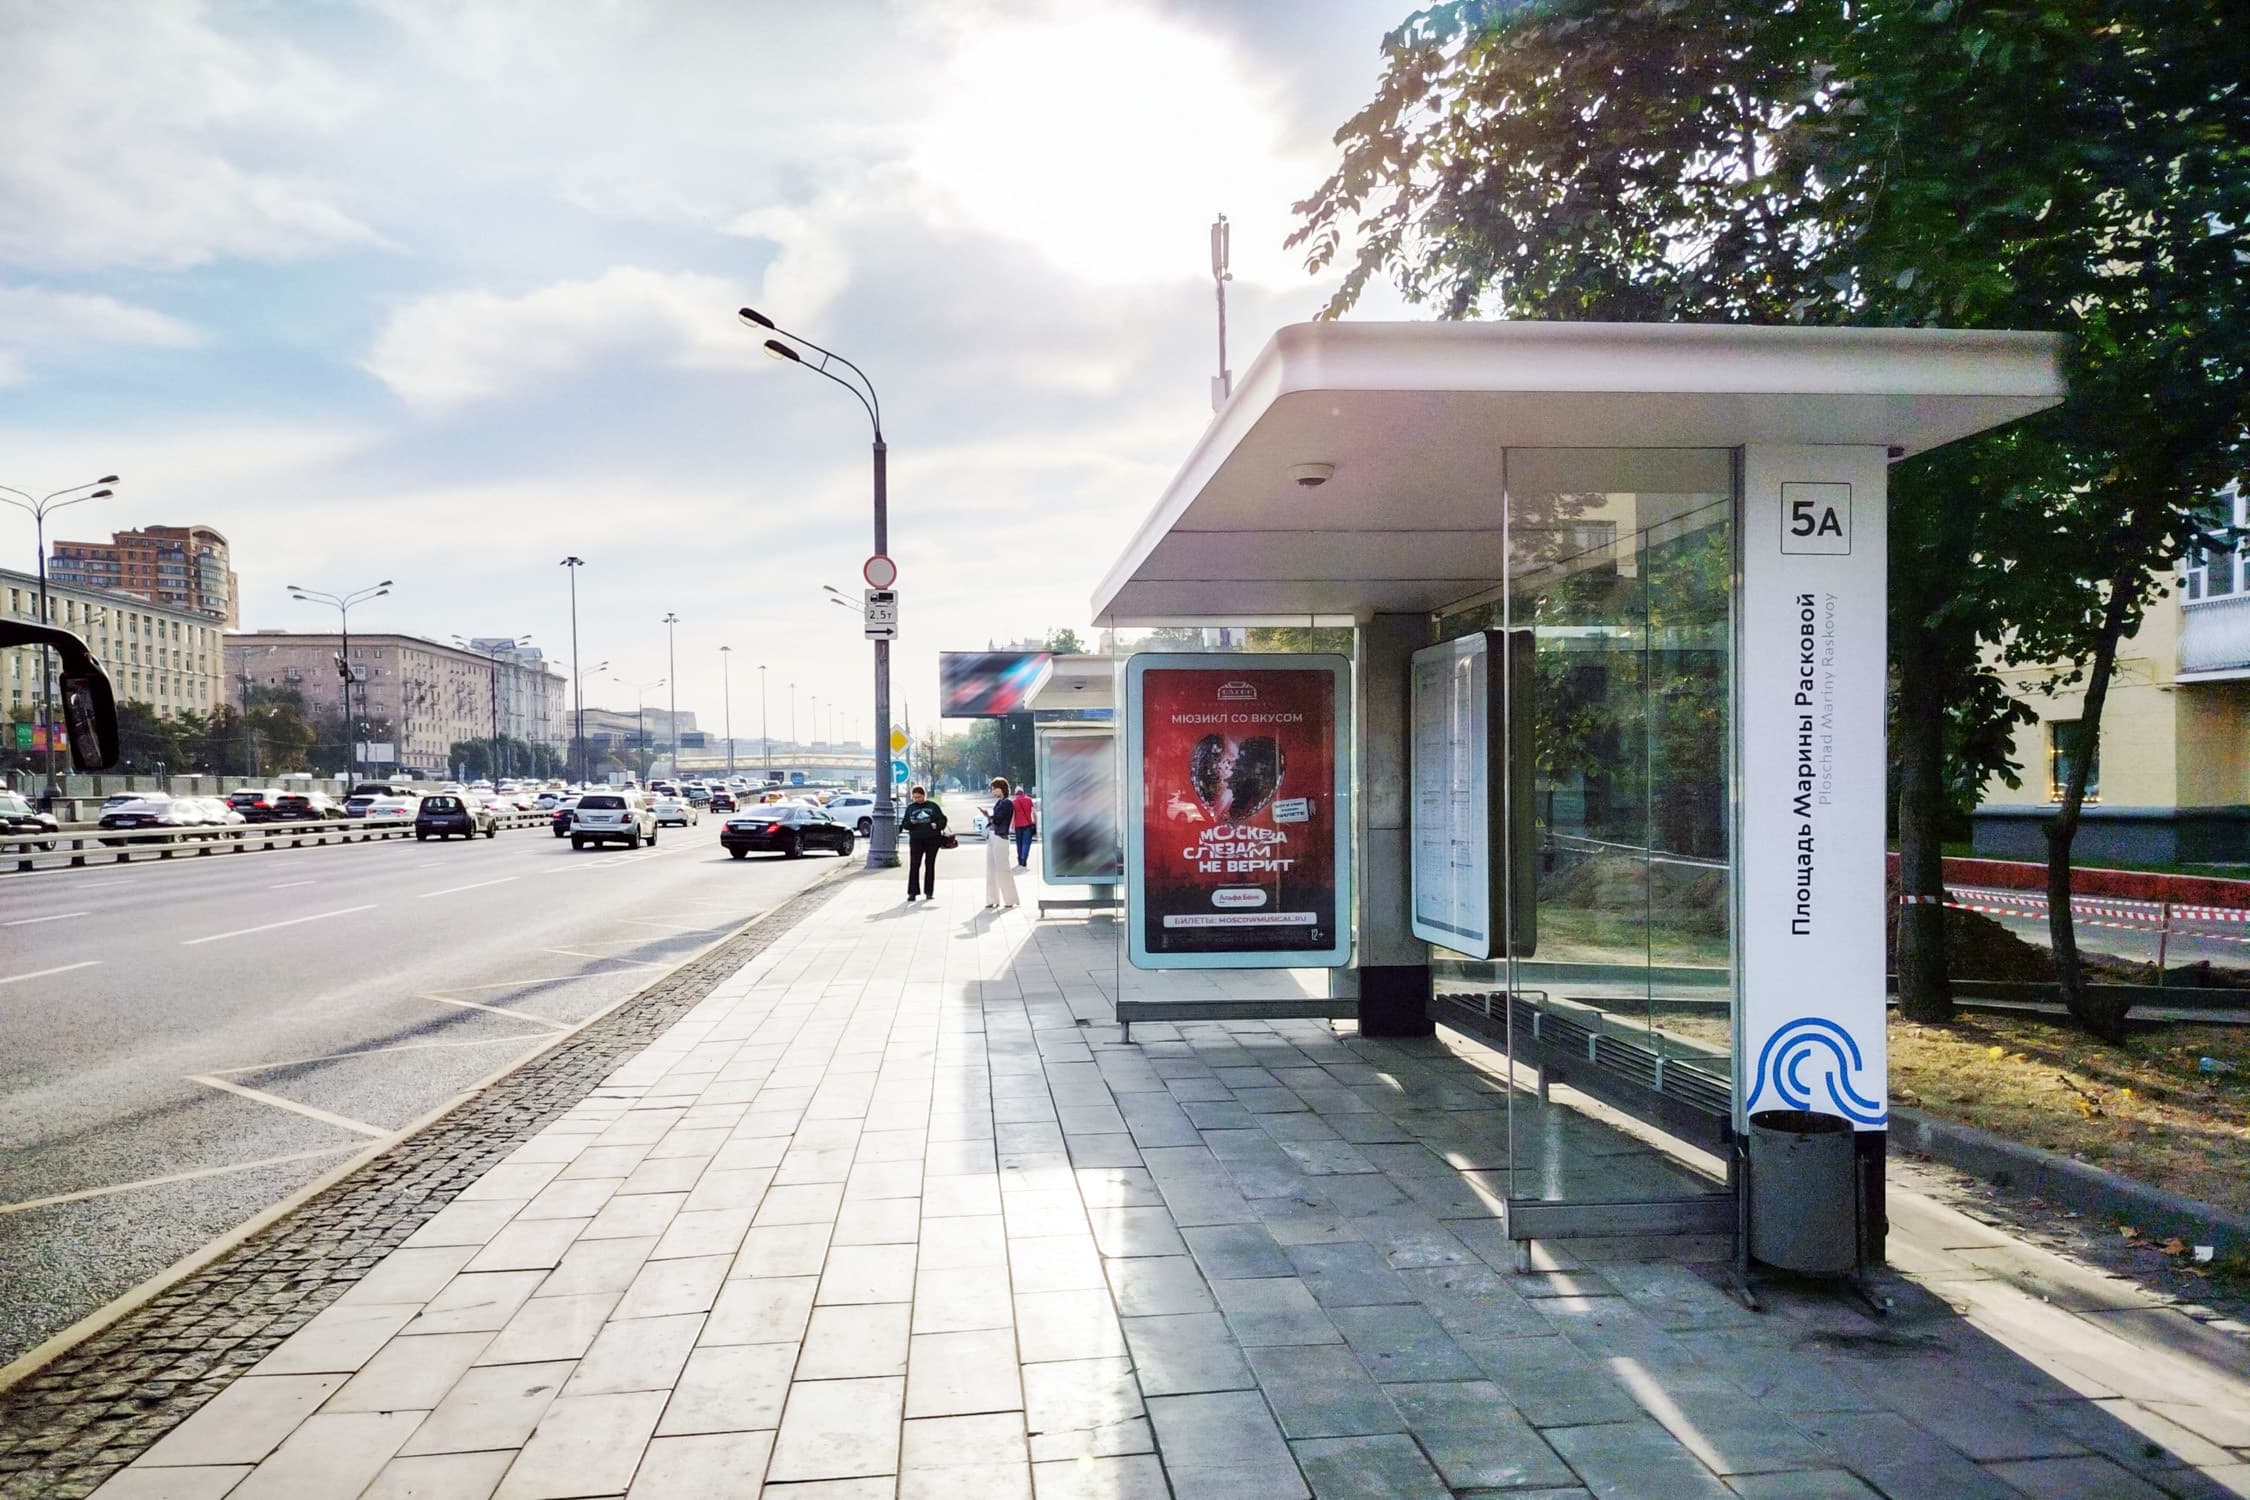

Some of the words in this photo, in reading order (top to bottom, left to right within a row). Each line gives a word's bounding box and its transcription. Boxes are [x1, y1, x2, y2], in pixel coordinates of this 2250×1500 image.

[1794, 593, 1815, 706] Расковой
[1820, 592, 1838, 666] Raskovoy
[1171, 713, 1228, 724] МЮЗИКЛ
[1231, 713, 1248, 723] СО
[1251, 713, 1303, 723] ВКУСОМ
[1820, 671, 1837, 729] Mariny
[1793, 715, 1816, 818] Марины
[1819, 734, 1833, 805] Ploschad
[1183, 842, 1271, 859] СЛЕЗАМ
[1199, 825, 1288, 844] МОСКВА
[1199, 860, 1222, 873] НЕ
[1227, 859, 1295, 873] ВЕРИТ
[1792, 824, 1815, 935] Площадь
